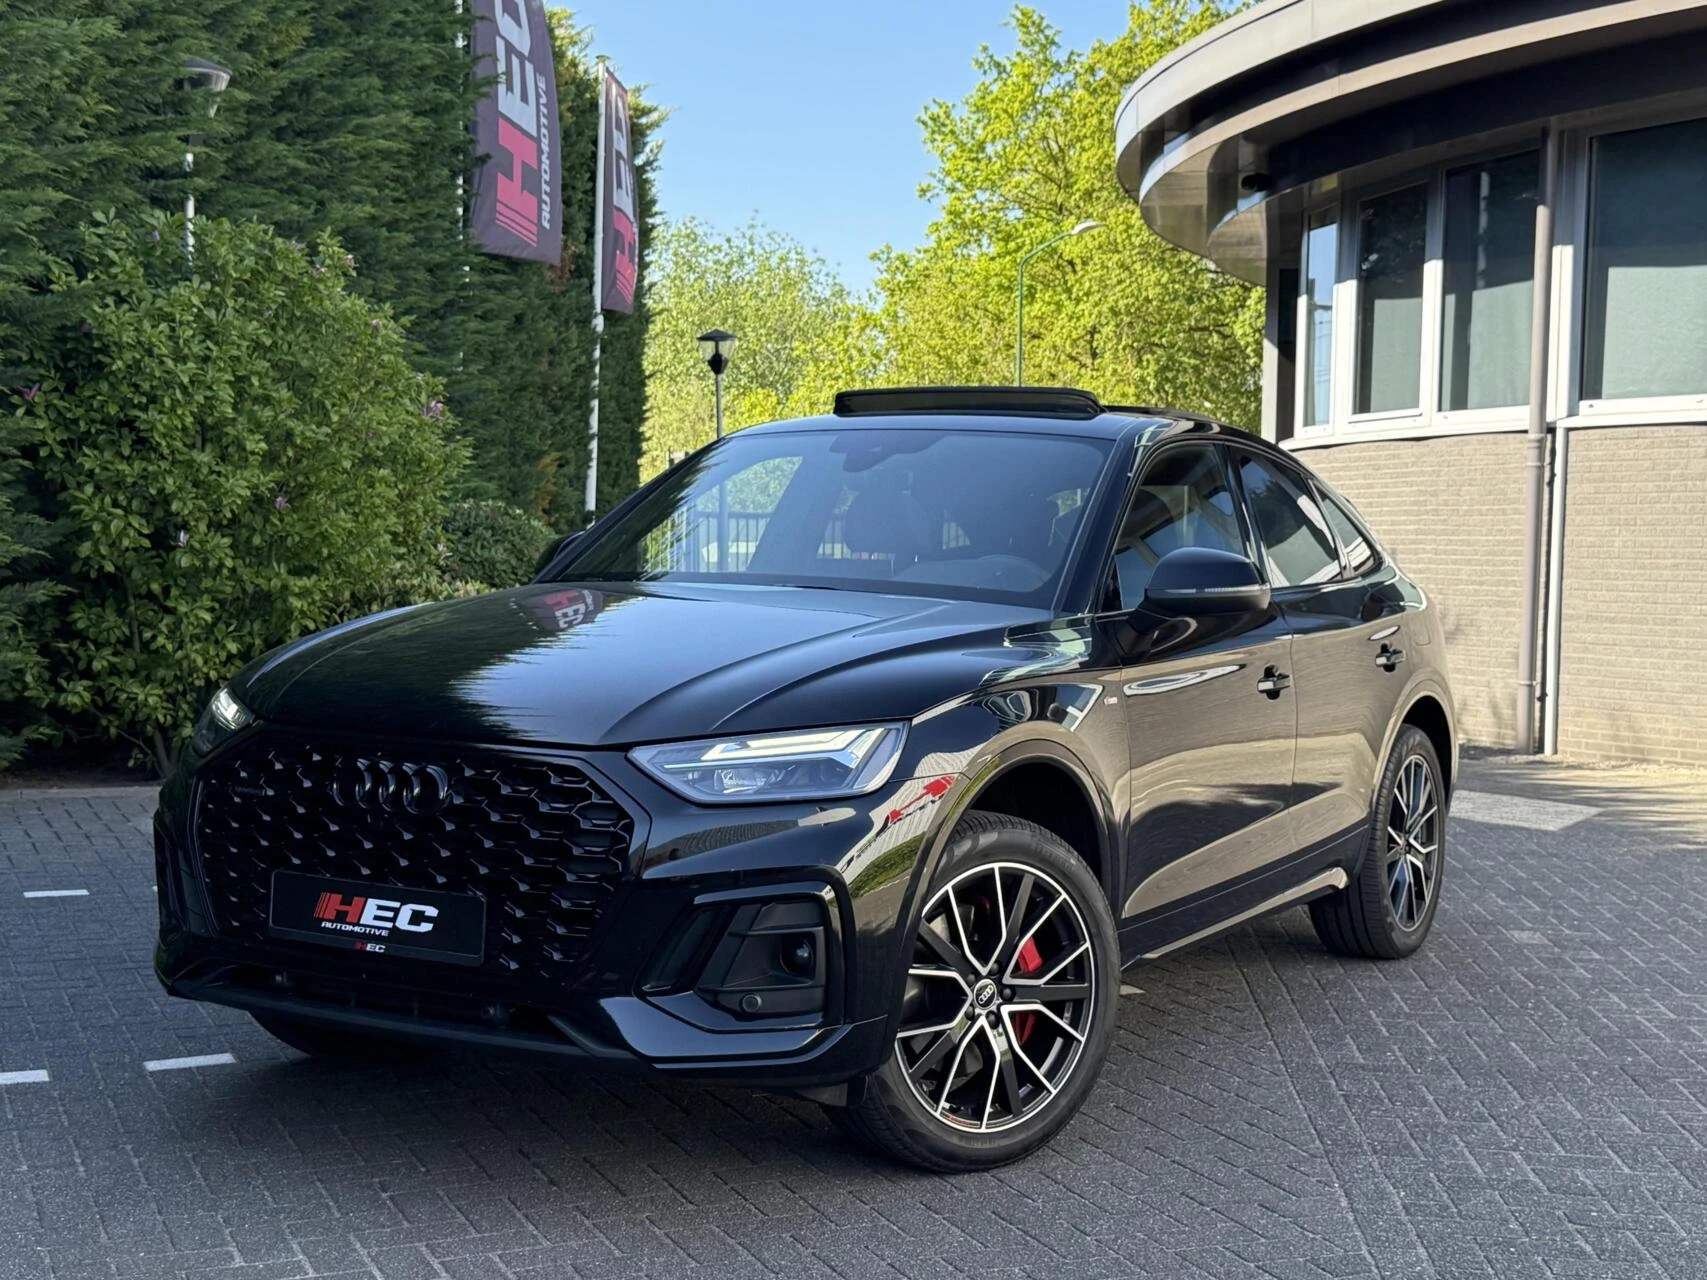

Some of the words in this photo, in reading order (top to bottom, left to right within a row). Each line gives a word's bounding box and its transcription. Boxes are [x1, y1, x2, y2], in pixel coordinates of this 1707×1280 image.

[537, 72, 550, 230] AUTOMOTIVE
[313, 891, 439, 933] HEC
[321, 922, 390, 937] AUTOMOTIVE
[355, 941, 386, 953] HEC
